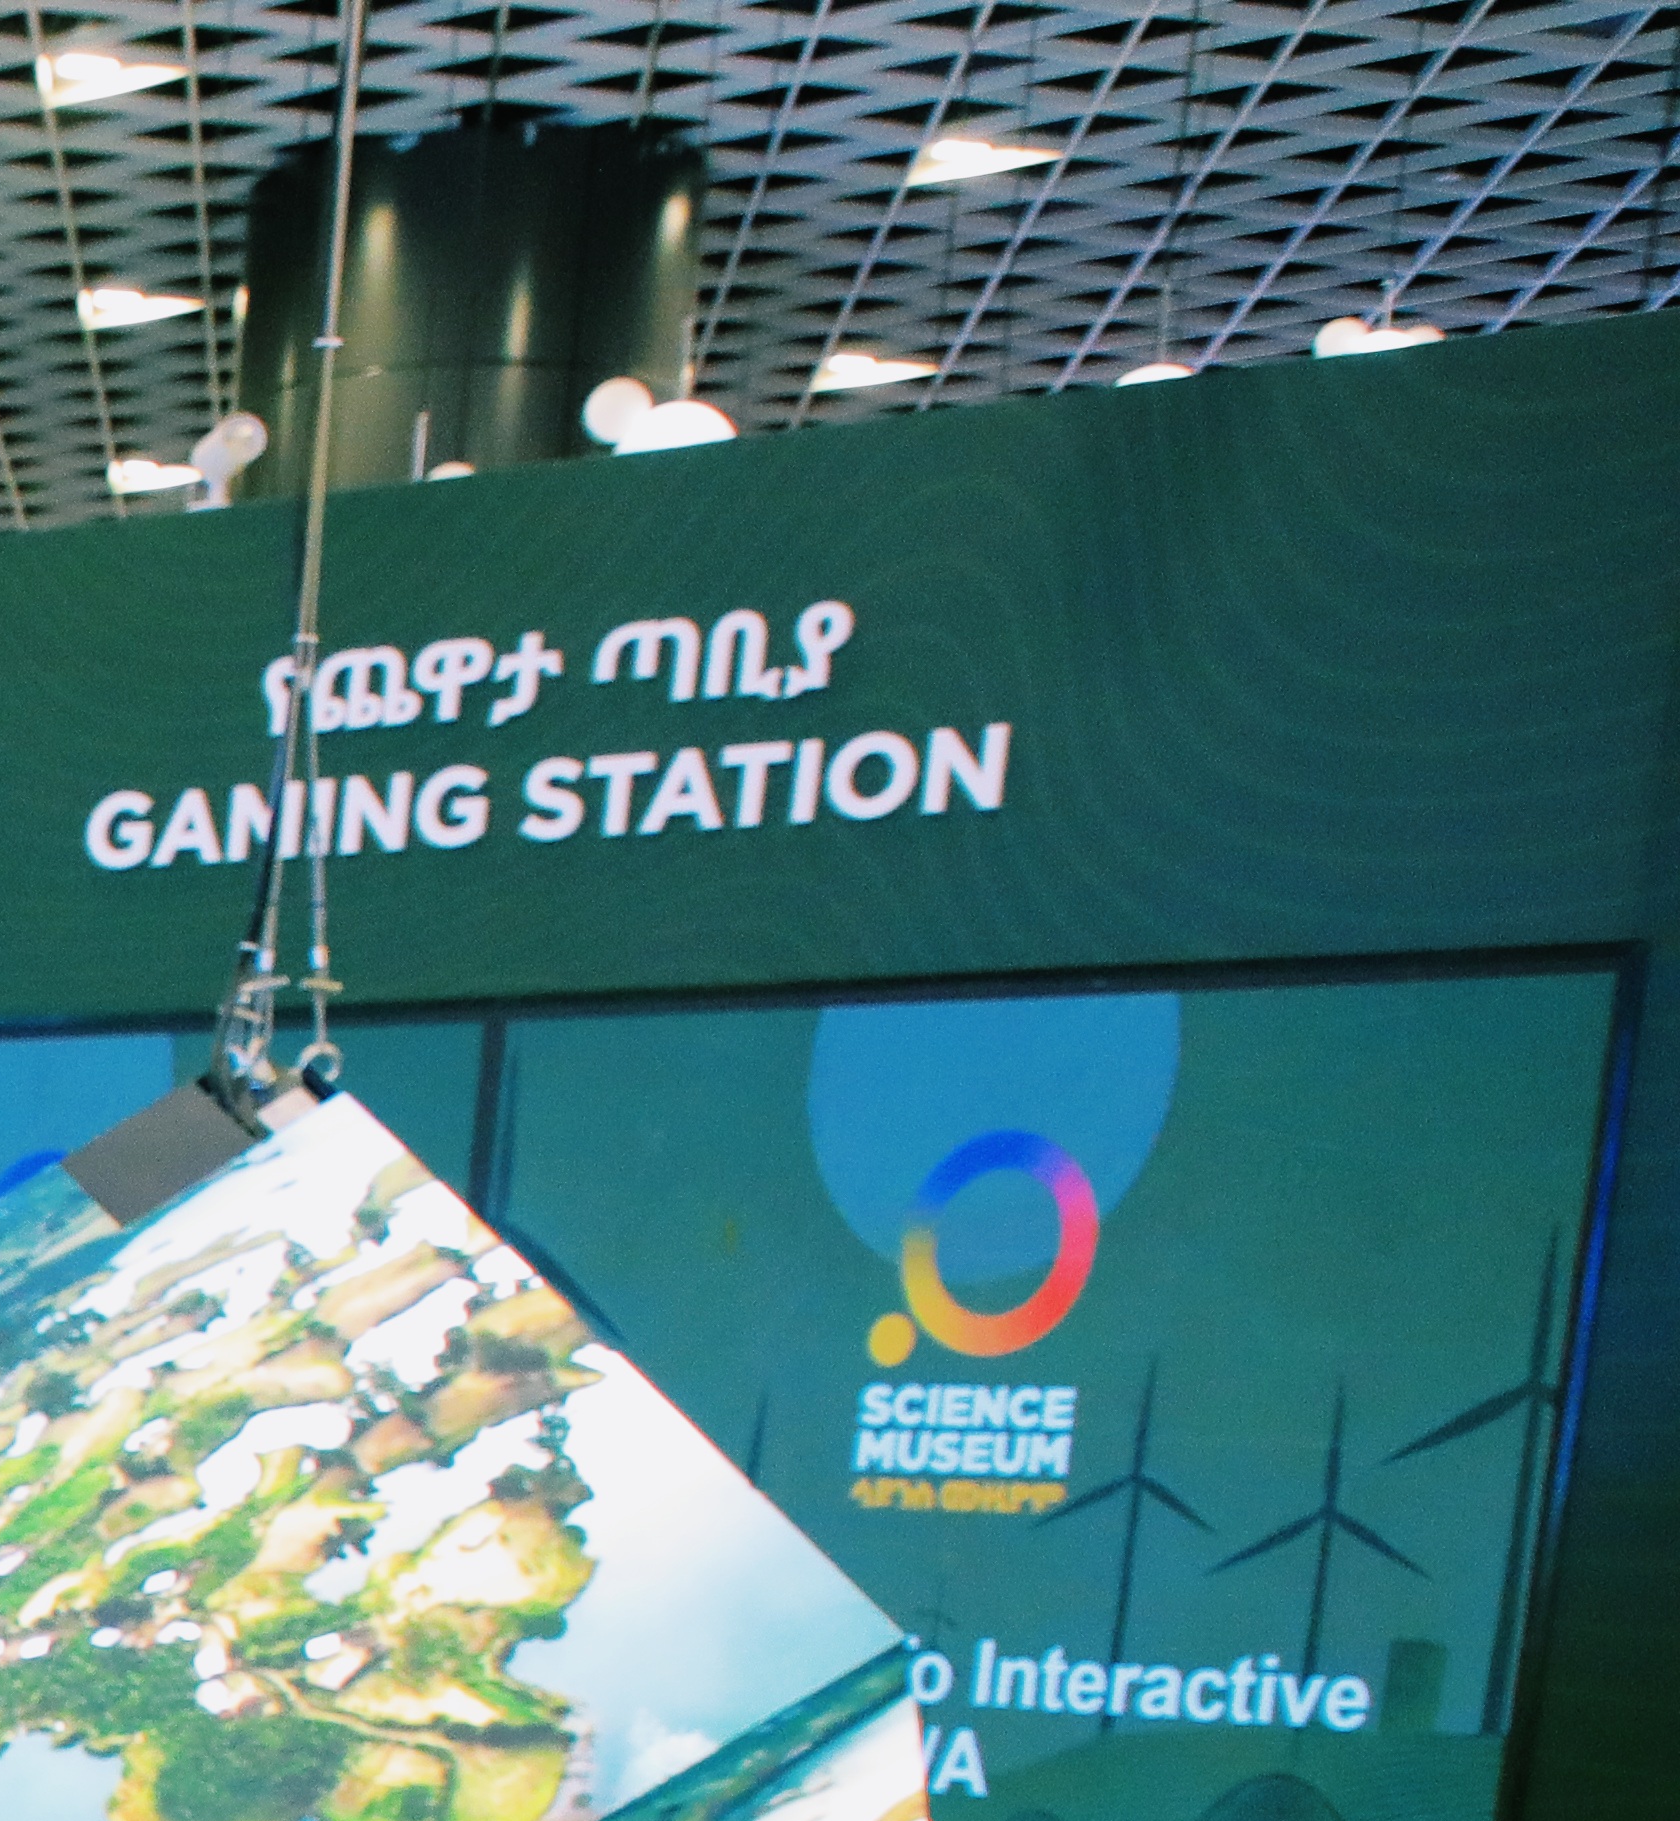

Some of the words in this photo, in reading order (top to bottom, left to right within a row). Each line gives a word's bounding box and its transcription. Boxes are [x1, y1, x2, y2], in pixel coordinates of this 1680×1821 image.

[592, 599, 855, 703] ጣቢያ
[84, 764, 490, 870] GAMING
[520, 722, 1012, 838] STATION
[852, 1429, 1073, 1480] MUSEUM
[857, 1381, 1078, 1431] SCIENCE
[972, 1635, 1372, 1732] Interactive
